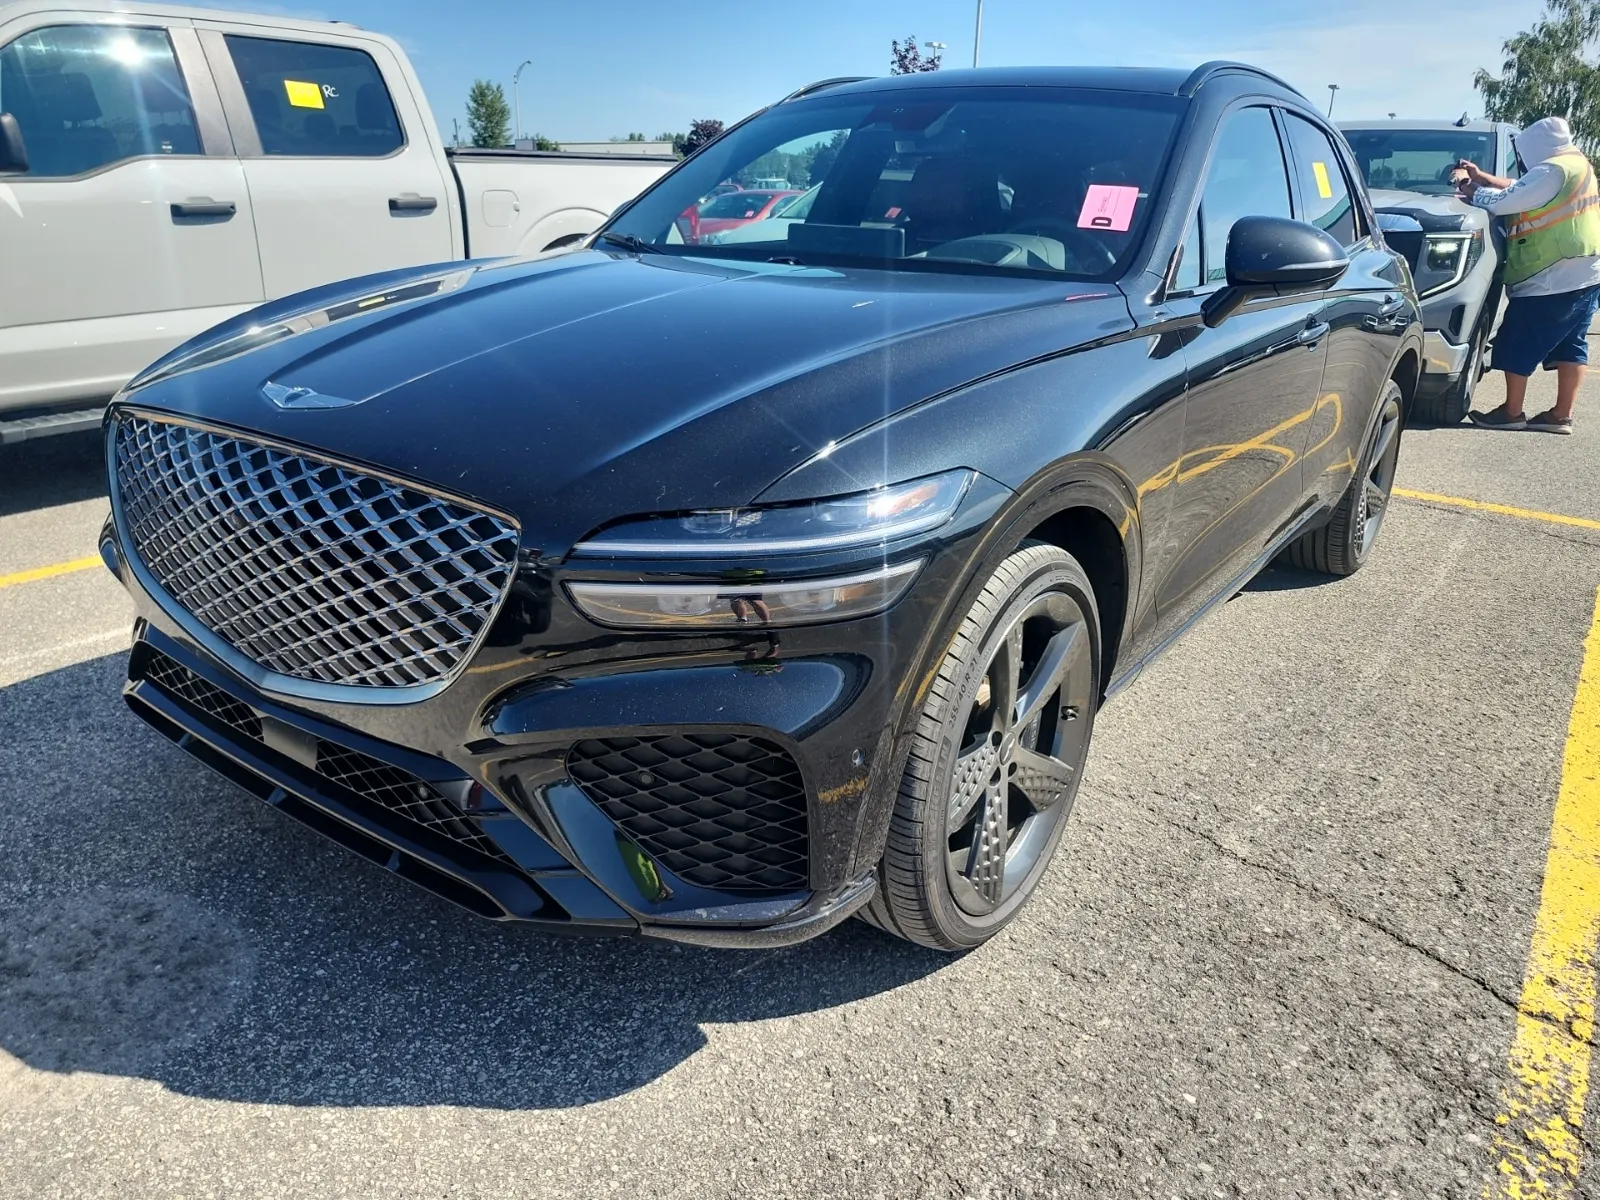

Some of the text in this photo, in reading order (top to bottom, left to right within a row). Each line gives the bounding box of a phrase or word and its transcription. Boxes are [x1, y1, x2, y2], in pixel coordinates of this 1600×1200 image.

[322, 84, 339, 98] RC
[1091, 216, 1112, 227] D
[948, 684, 966, 728] 255/40
